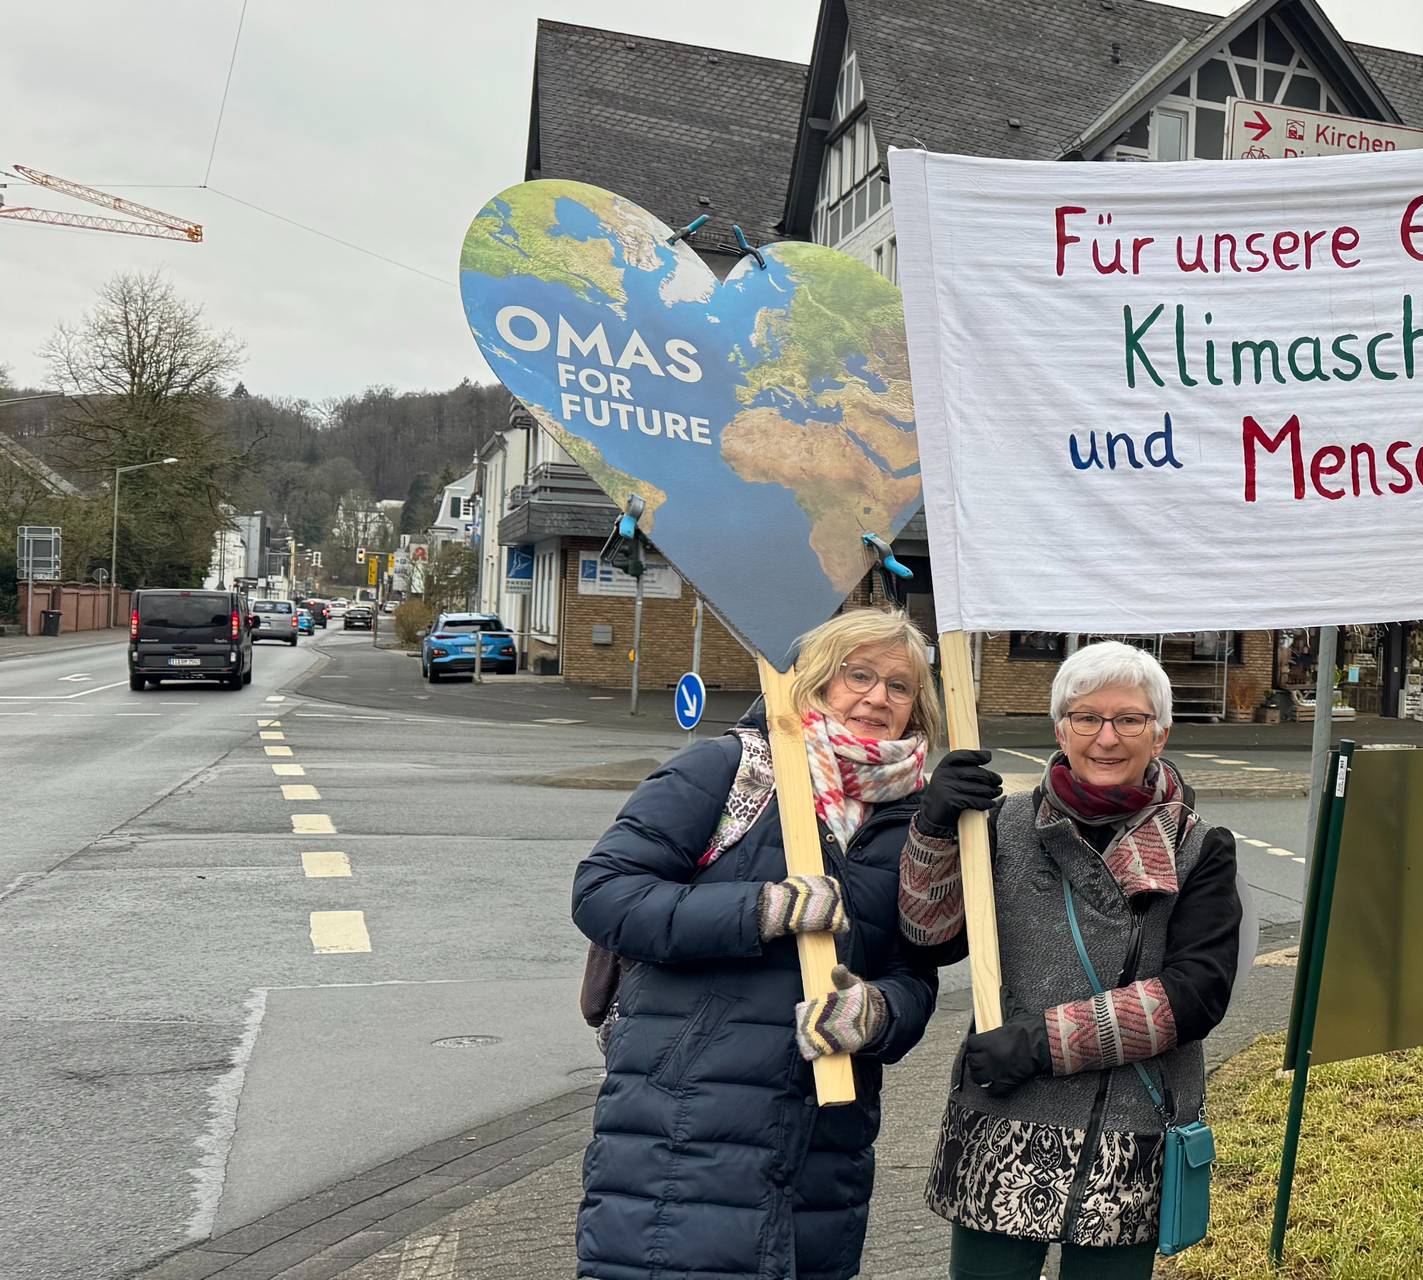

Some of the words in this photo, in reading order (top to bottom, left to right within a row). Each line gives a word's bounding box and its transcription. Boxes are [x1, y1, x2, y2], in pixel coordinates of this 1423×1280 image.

[1315, 123, 1396, 153] Kirchen
[1055, 206, 1154, 276] Für
[1176, 227, 1361, 273] unsere
[495, 305, 703, 383] OMAS
[557, 362, 634, 400] FOR
[560, 392, 713, 445] FUTURE
[1069, 412, 1184, 470] und
